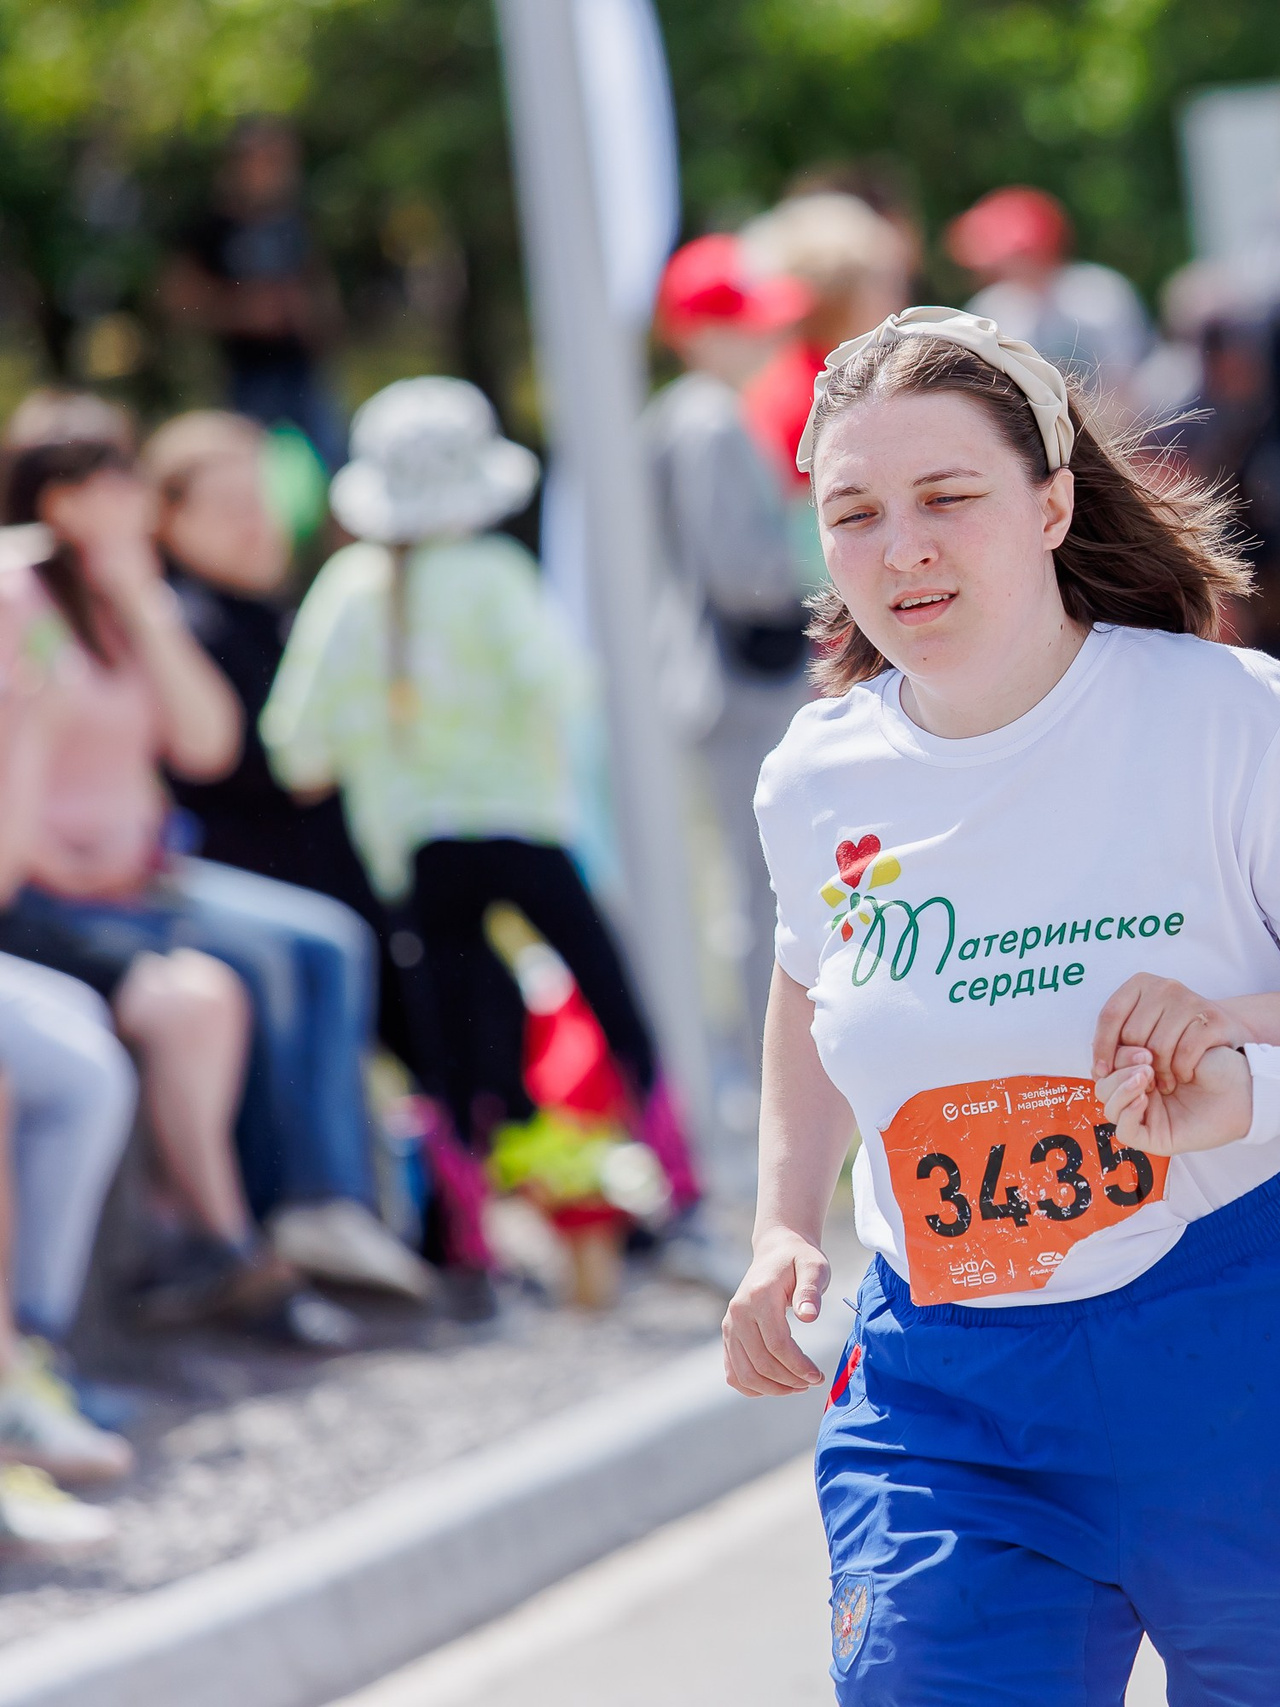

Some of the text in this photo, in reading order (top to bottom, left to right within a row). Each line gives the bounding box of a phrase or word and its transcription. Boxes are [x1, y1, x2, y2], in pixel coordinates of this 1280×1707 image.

[948, 961, 1085, 1006] сердце
[1021, 1085, 1068, 1100] зелёный
[961, 1100, 998, 1116] СБЕР
[1017, 1095, 1066, 1111] марафон
[916, 1122, 1154, 1238] 3435
[952, 1271, 997, 1287] 450
